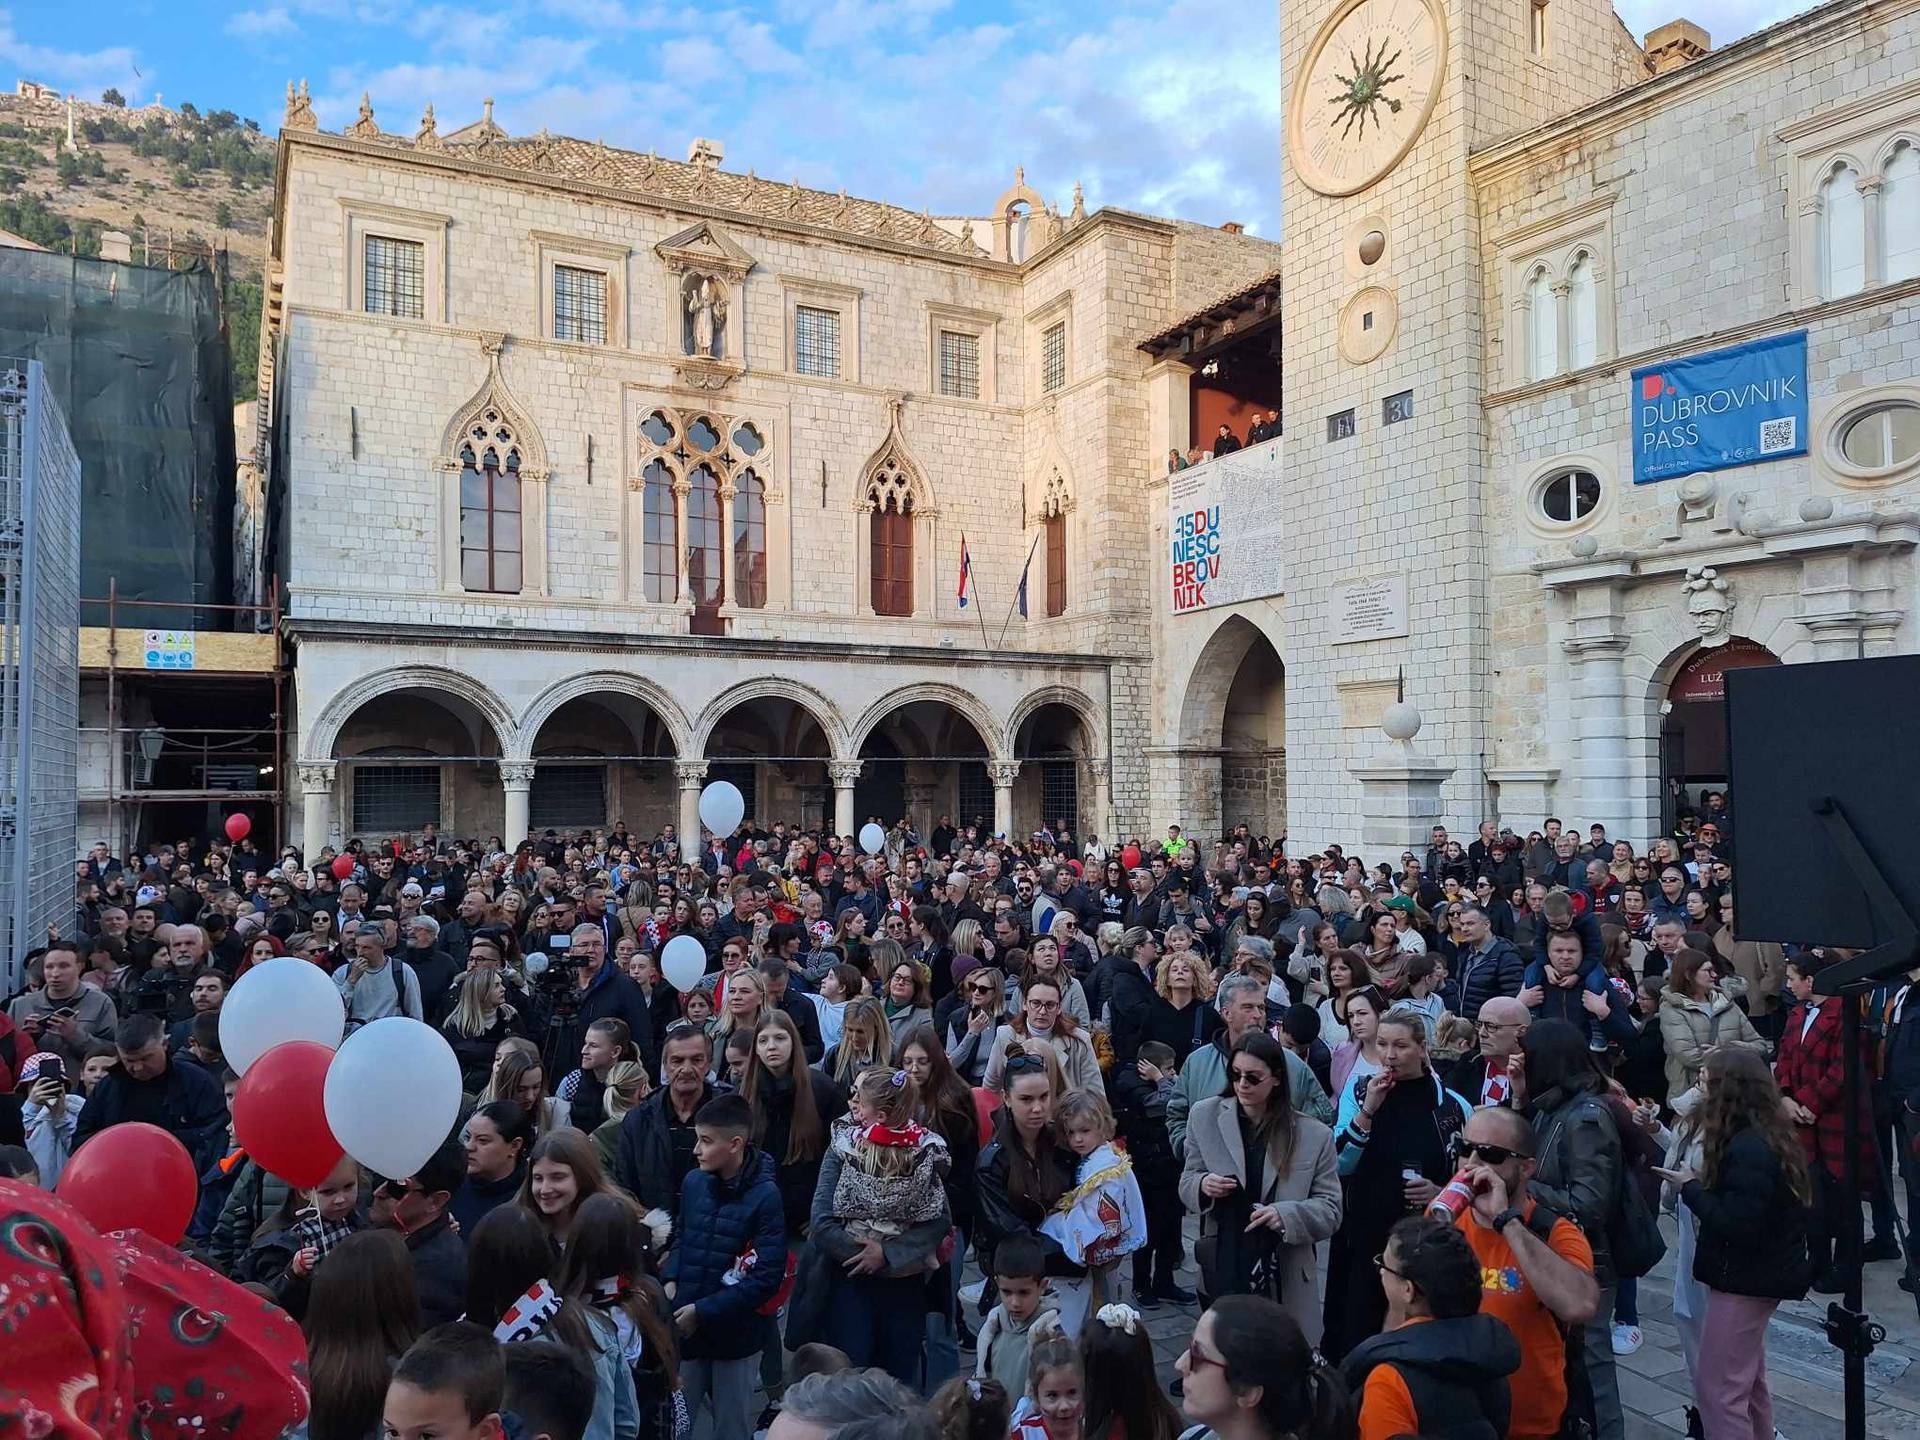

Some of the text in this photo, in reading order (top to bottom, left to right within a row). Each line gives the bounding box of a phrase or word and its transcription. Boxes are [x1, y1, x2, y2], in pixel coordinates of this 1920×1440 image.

[1643, 375, 1797, 427] DUBROVNIK
[1643, 424, 1699, 454] PASS
[1173, 531, 1220, 564] NESC
[1173, 554, 1220, 588] BROV
[1174, 582, 1206, 610] NIK
[1701, 671, 1723, 683] LUŽ
